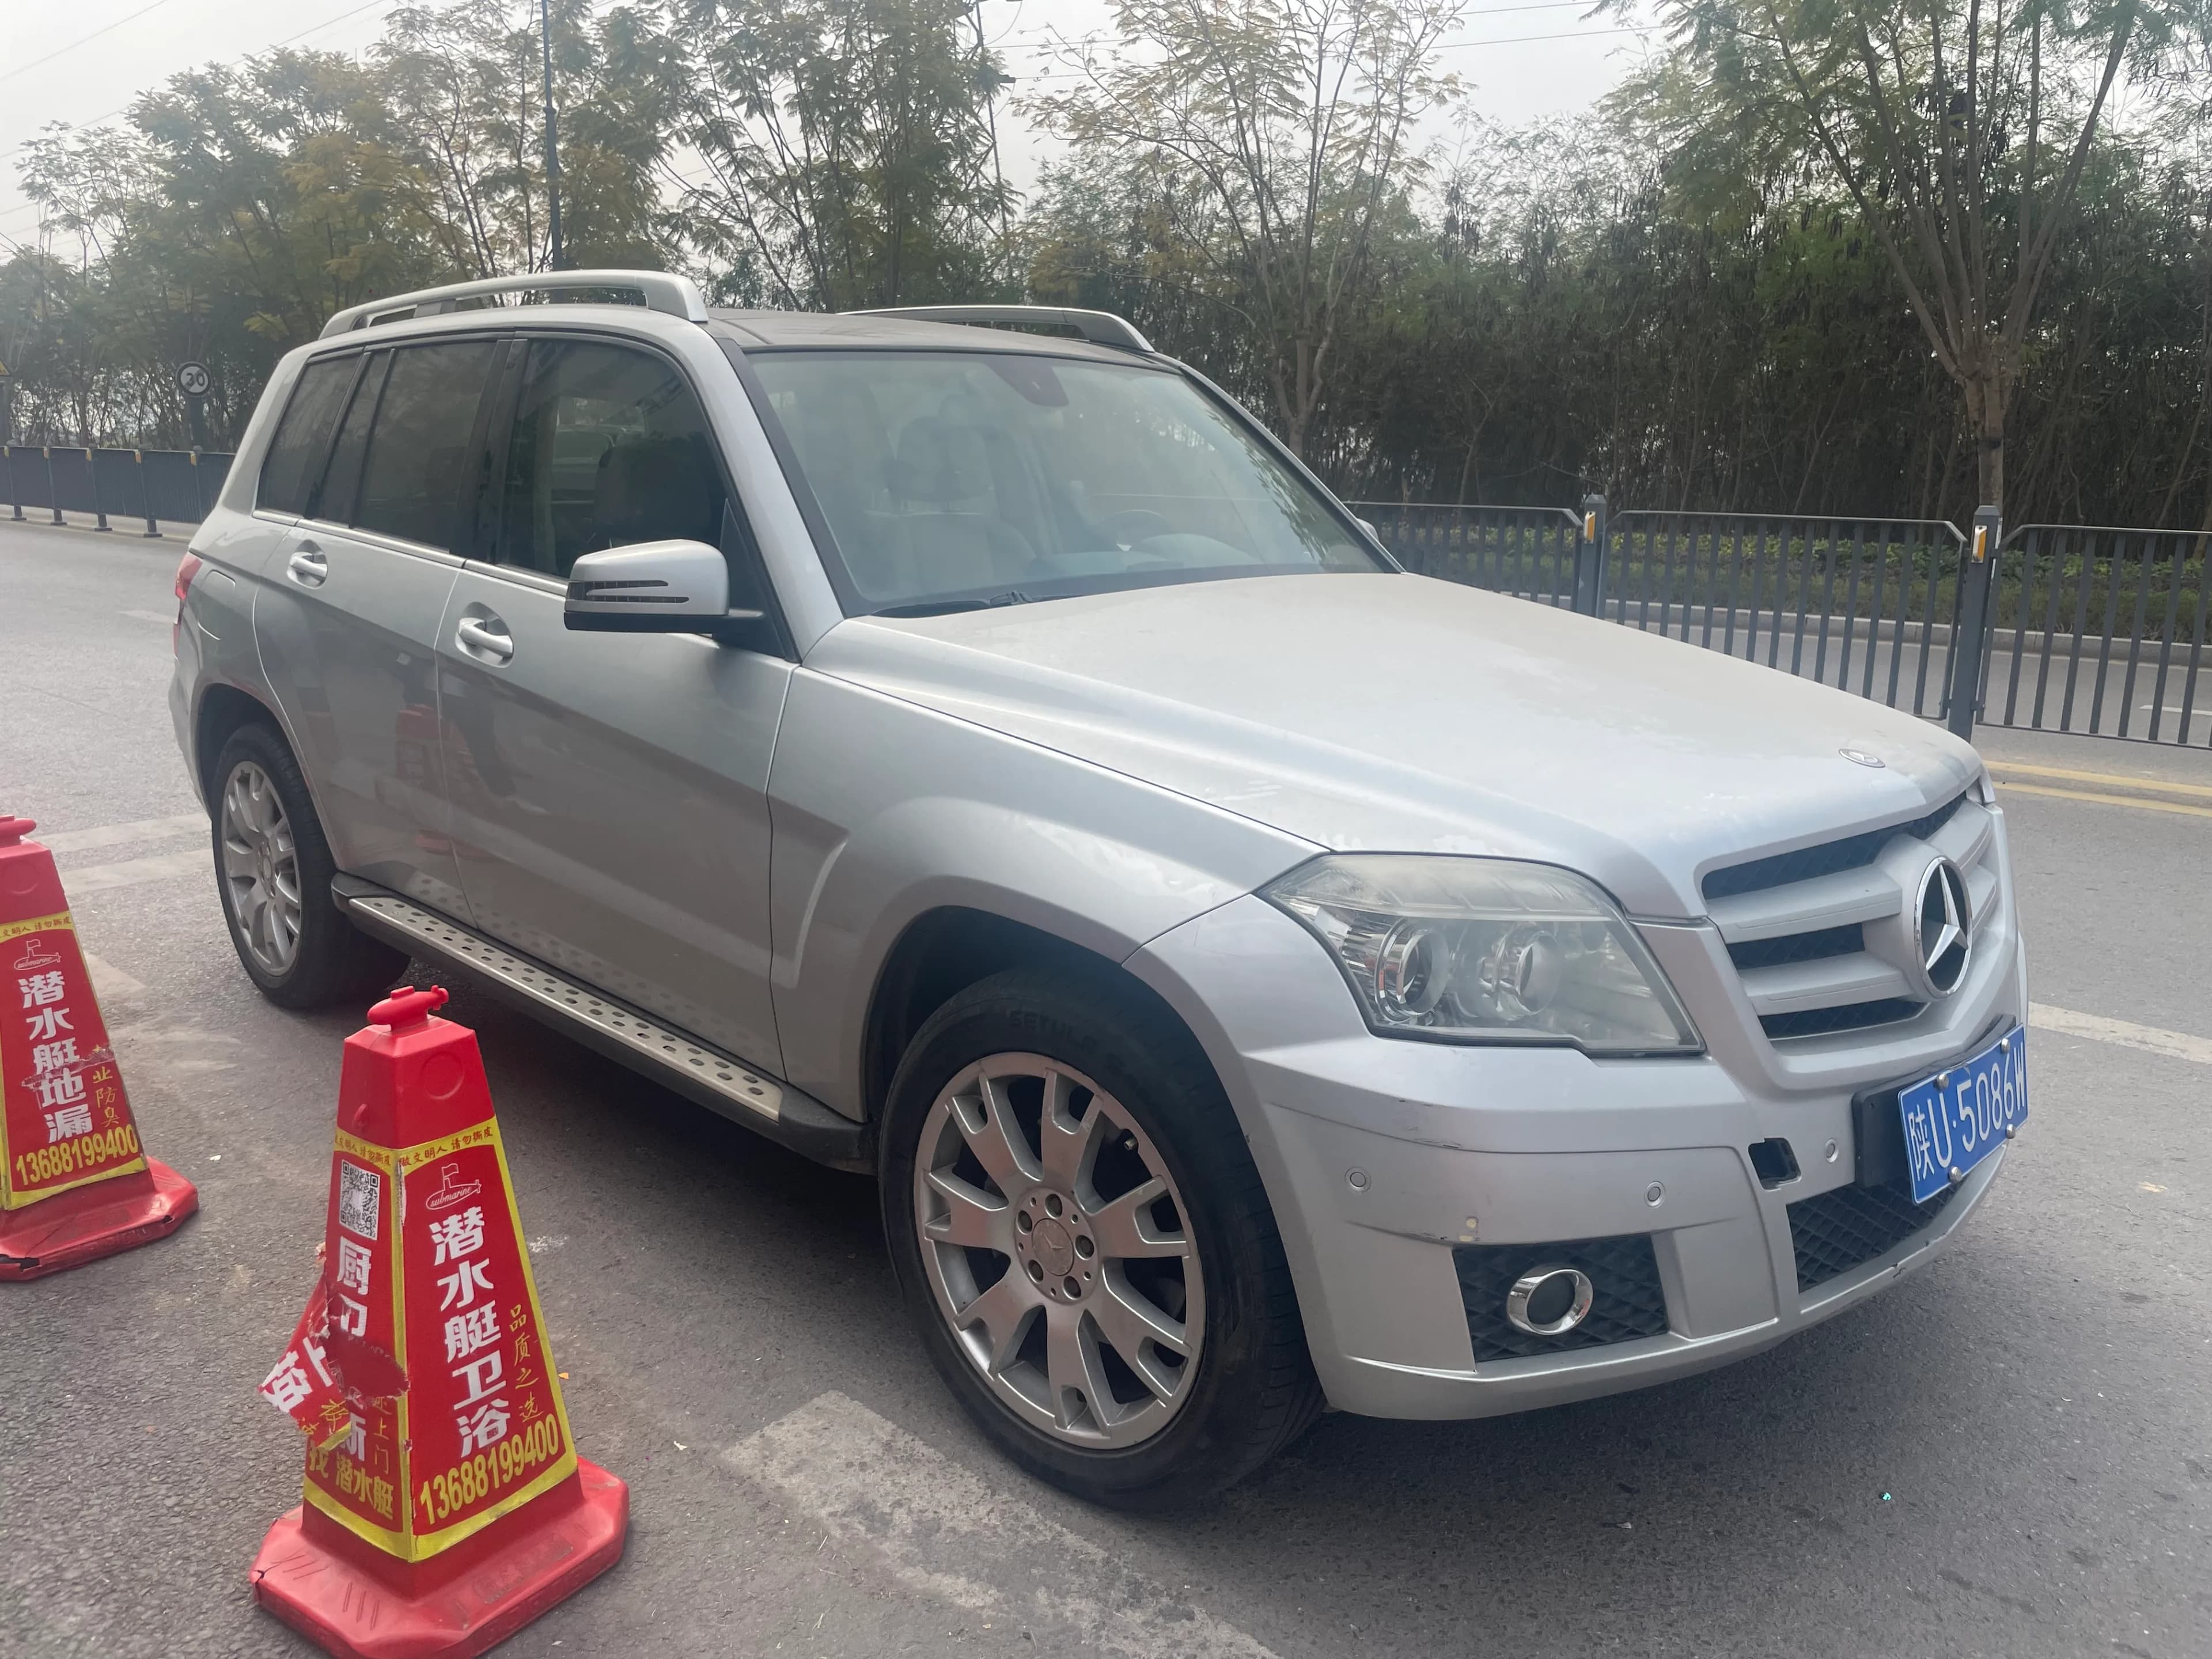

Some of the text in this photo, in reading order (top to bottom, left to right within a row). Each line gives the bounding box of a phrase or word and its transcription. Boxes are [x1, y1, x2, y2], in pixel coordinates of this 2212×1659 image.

[0, 926, 31, 938] 文明人
[18, 971, 93, 1143] 潜水艇地漏
[16, 1123, 139, 1186] 13688199400
[430, 1185, 472, 1207] submarine
[429, 1206, 511, 1459] 潜水艇卫浴
[509, 1304, 544, 1423] 品质之选
[420, 1412, 559, 1525] 13688199400
